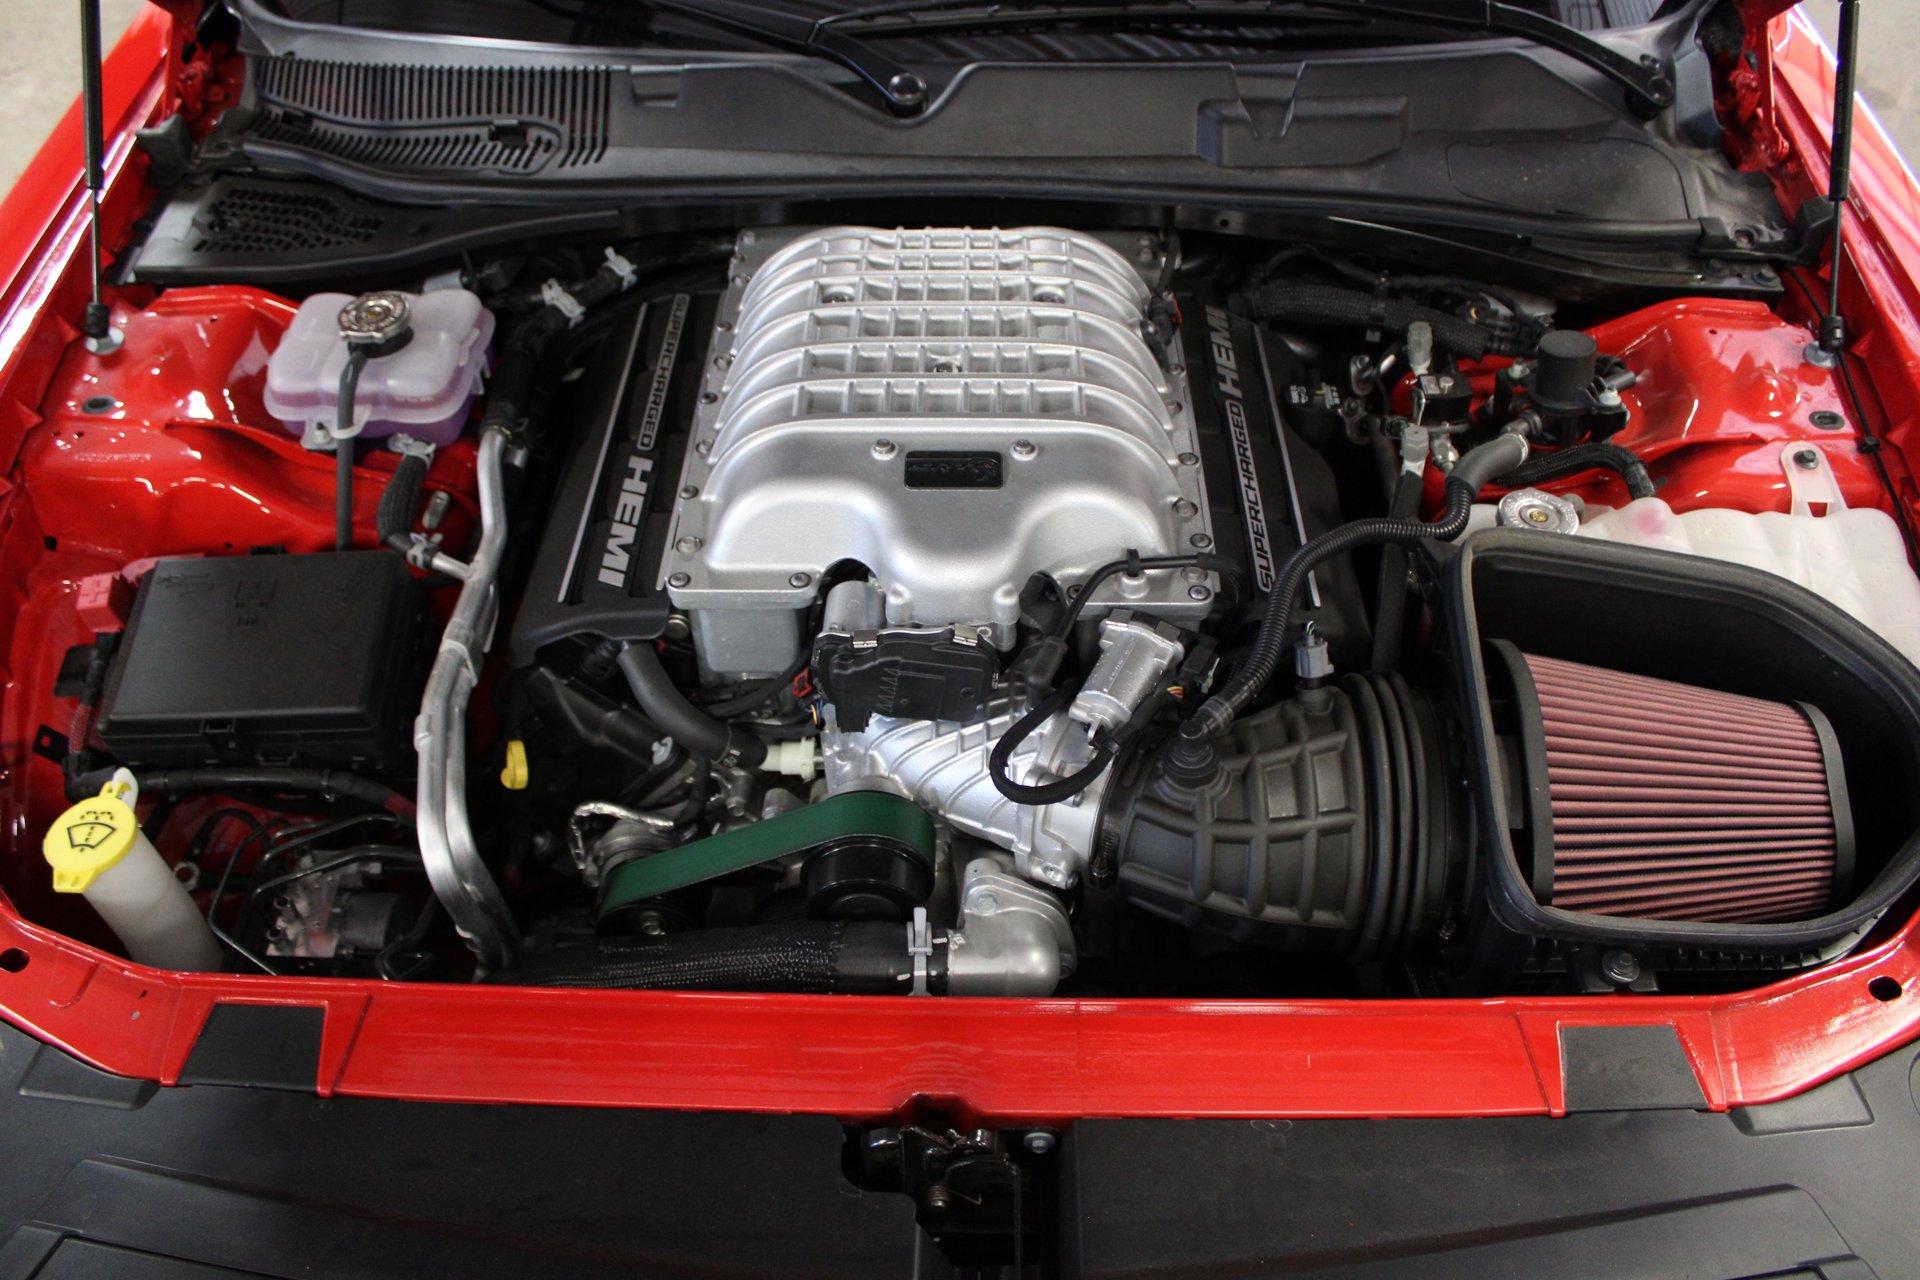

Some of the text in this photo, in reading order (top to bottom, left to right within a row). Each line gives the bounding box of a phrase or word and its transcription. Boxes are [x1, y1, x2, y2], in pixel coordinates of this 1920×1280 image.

[598, 295, 688, 587] SUPERCHARGED HEMI
[1206, 305, 1275, 592] SUPERCHARGED HEMI
